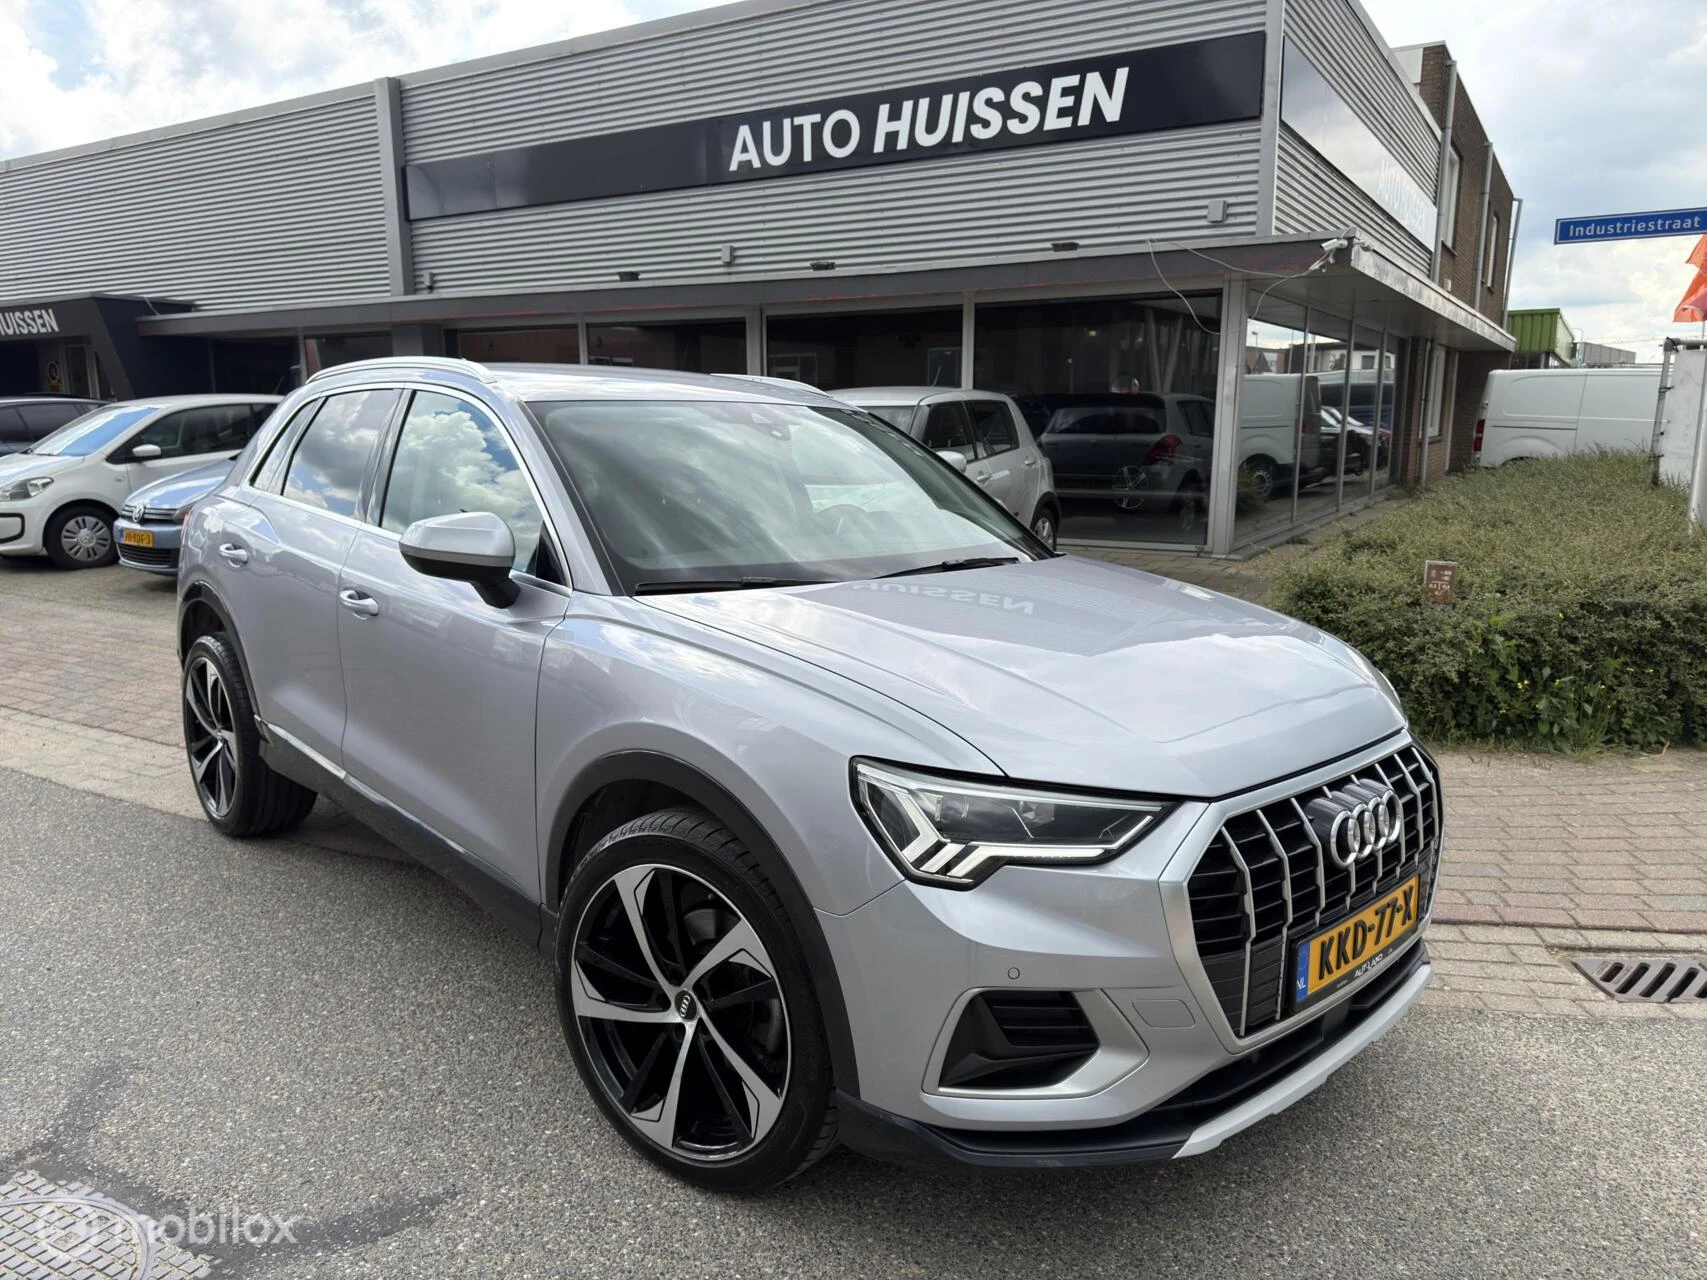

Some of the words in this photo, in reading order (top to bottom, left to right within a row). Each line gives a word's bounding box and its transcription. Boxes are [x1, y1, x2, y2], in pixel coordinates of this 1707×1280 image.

[729, 109, 861, 172] AUTO
[873, 67, 1129, 153] HUISSEN
[1569, 215, 1701, 237] Industriestraat
[1318, 885, 1415, 980] KKD-77-X
